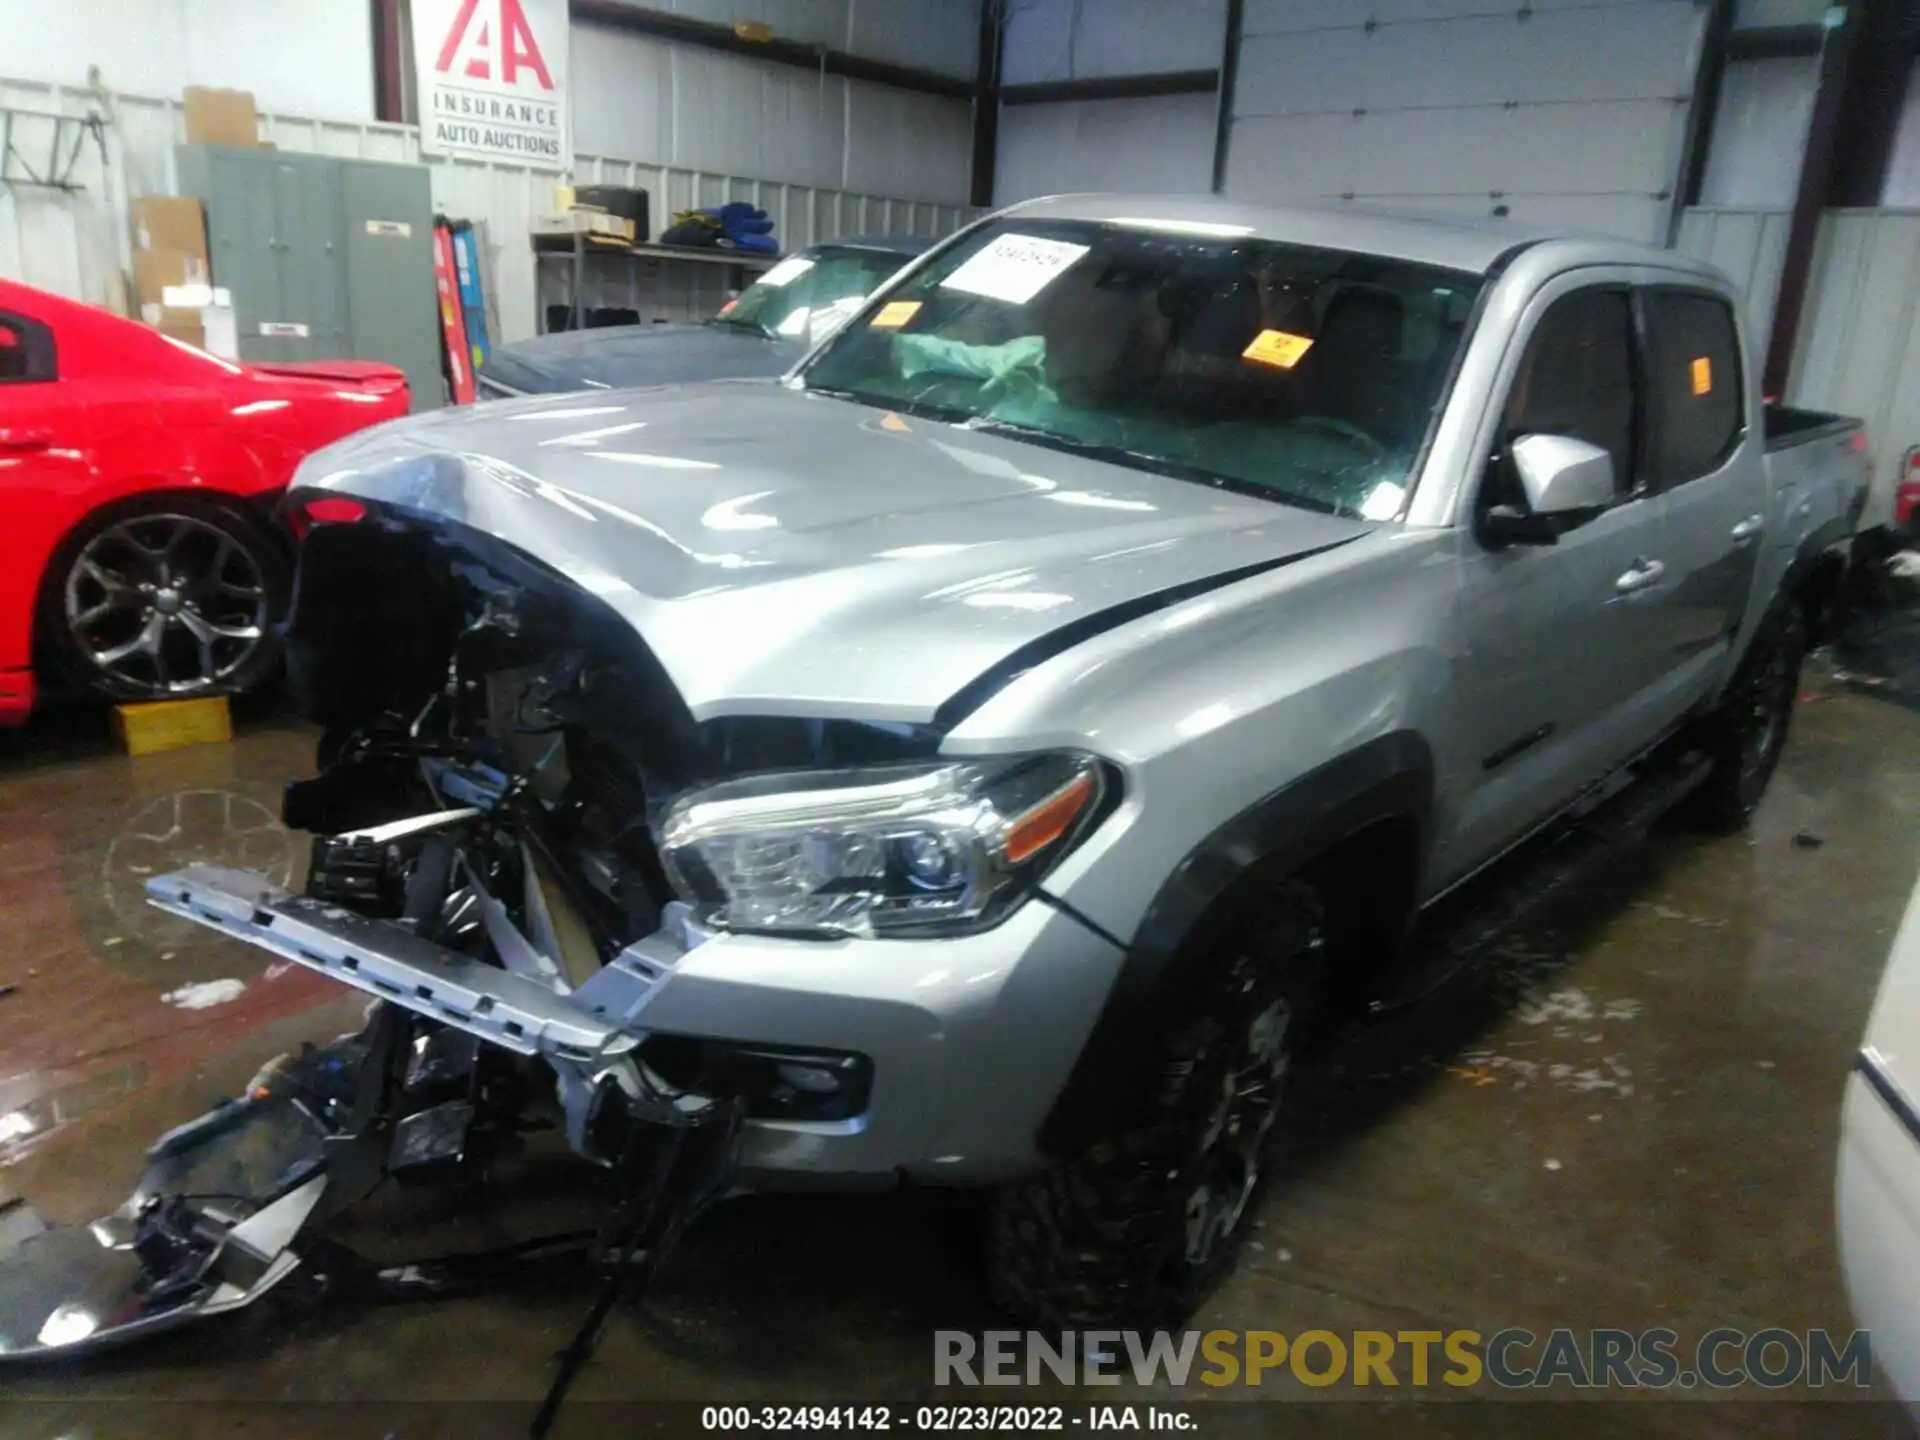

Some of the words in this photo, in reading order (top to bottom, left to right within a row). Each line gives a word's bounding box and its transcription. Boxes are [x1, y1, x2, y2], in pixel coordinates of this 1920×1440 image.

[434, 92, 557, 126] INSURANCE
[437, 123, 479, 145] AUTO
[484, 129, 559, 155] AUCTIONS
